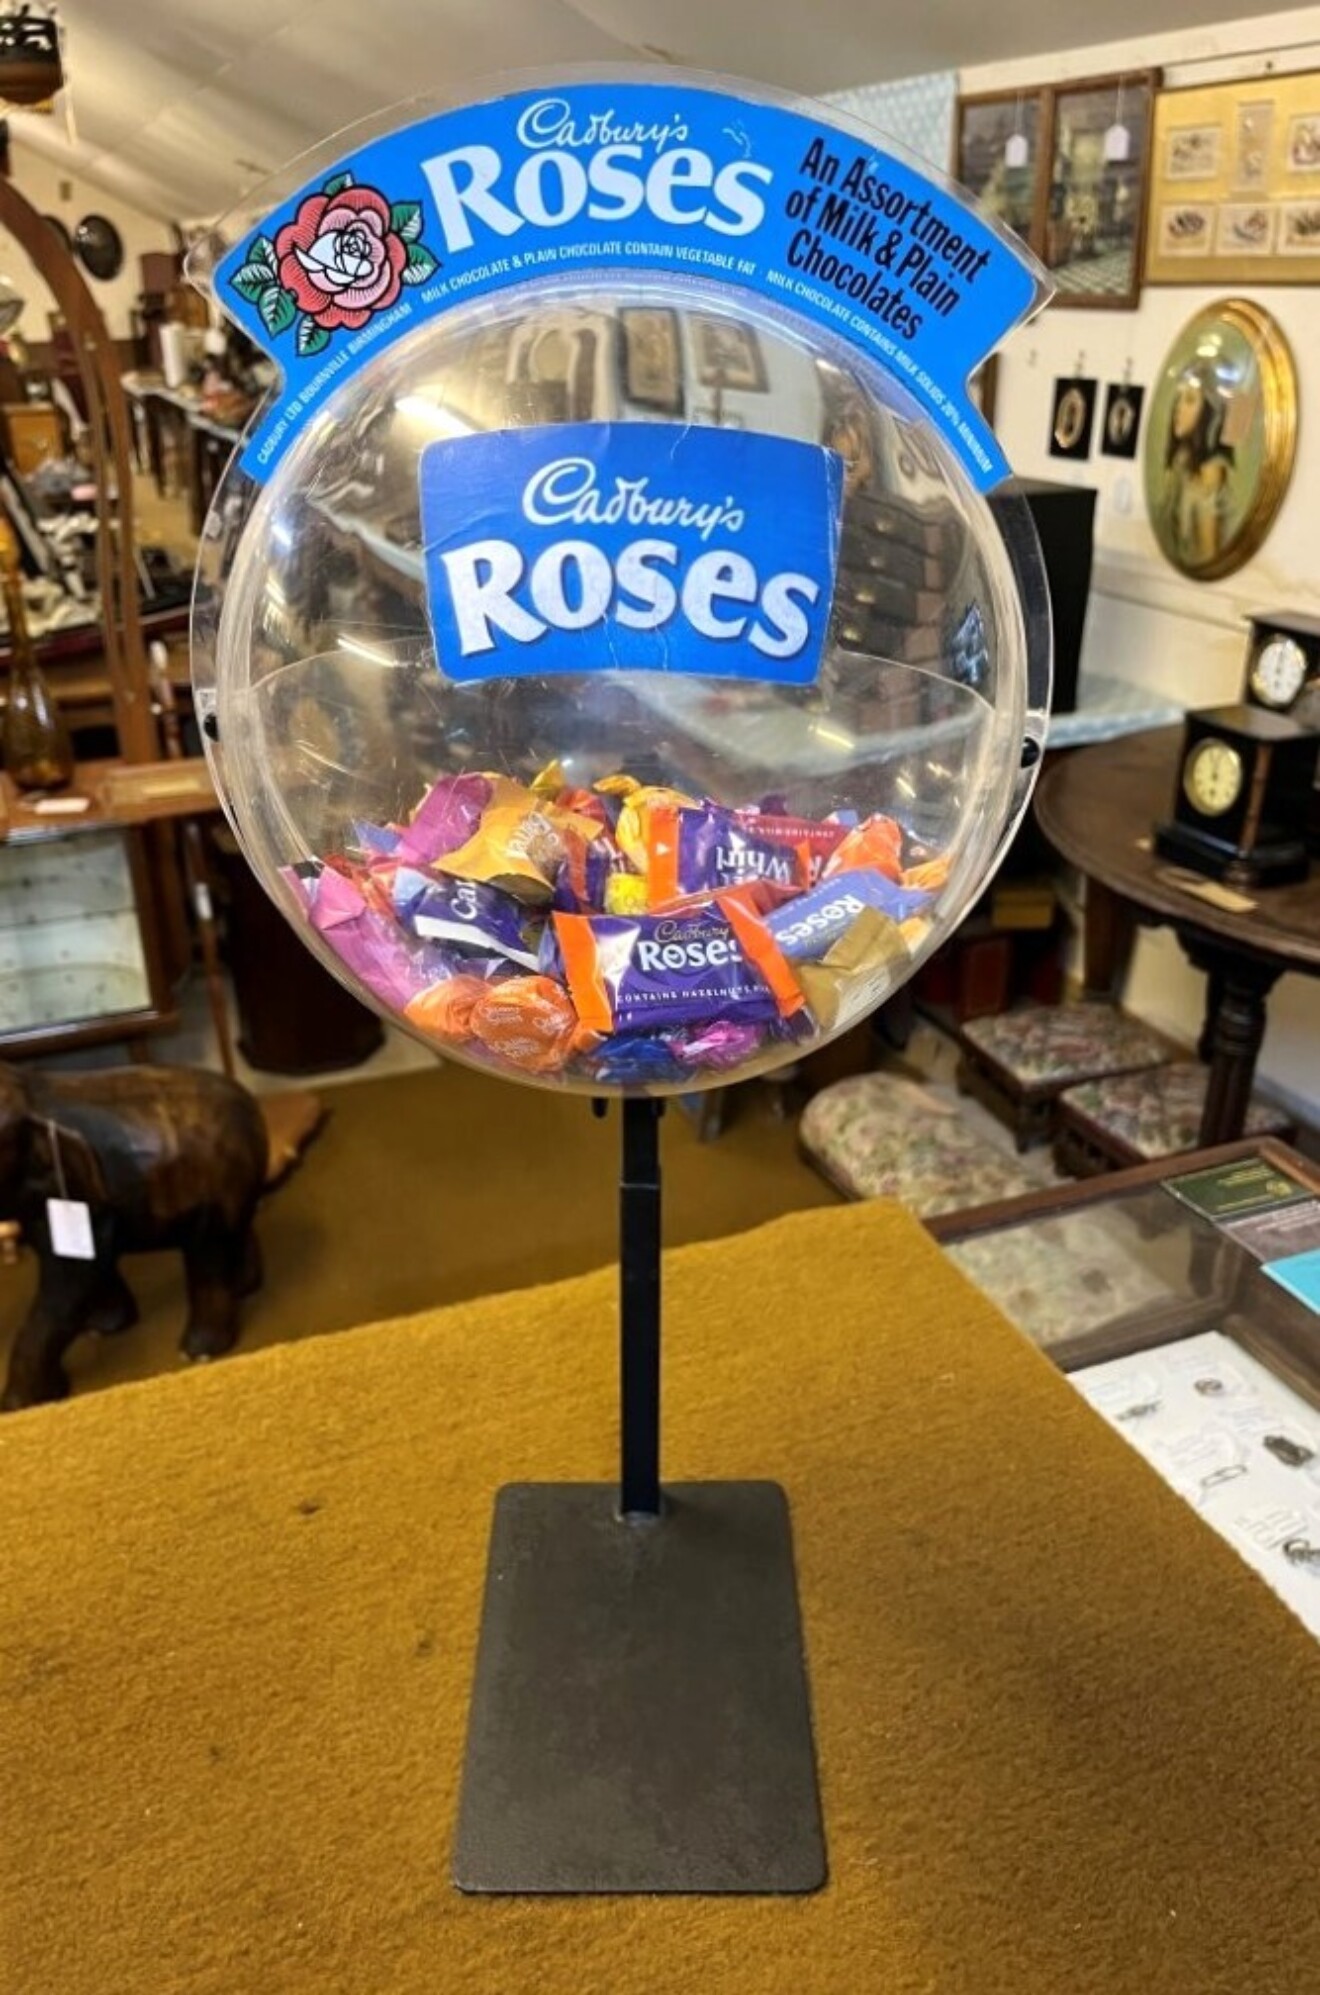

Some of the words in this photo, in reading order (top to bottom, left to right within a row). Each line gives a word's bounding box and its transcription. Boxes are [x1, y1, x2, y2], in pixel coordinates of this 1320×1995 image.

[516, 98, 689, 153] Cadbury's
[420, 144, 774, 253] Roses
[799, 137, 841, 187] An
[840, 156, 992, 283] Assortment
[421, 285, 449, 304] MILK
[450, 259, 511, 291] CHOCOLATE
[512, 255, 523, 269] &
[523, 247, 557, 266] PLAIN
[559, 241, 622, 260] CHOCOLATE
[625, 241, 673, 259] CONTAIN
[675, 246, 735, 271] VEGETABLE
[737, 257, 758, 277] FAT
[785, 186, 822, 223] of
[815, 193, 879, 256] Milk
[874, 229, 903, 270] &
[895, 243, 960, 317] Plain
[787, 229, 923, 340] Chocolates
[766, 269, 794, 292] MILK
[794, 281, 852, 322] CHOCOLATE
[257, 418, 290, 465] CADBURY
[285, 400, 304, 421] LTD
[522, 457, 745, 541] Cadbury's
[440, 538, 820, 660] Roses
[716, 847, 791, 886] Whirl
[775, 893, 866, 945] Roses
